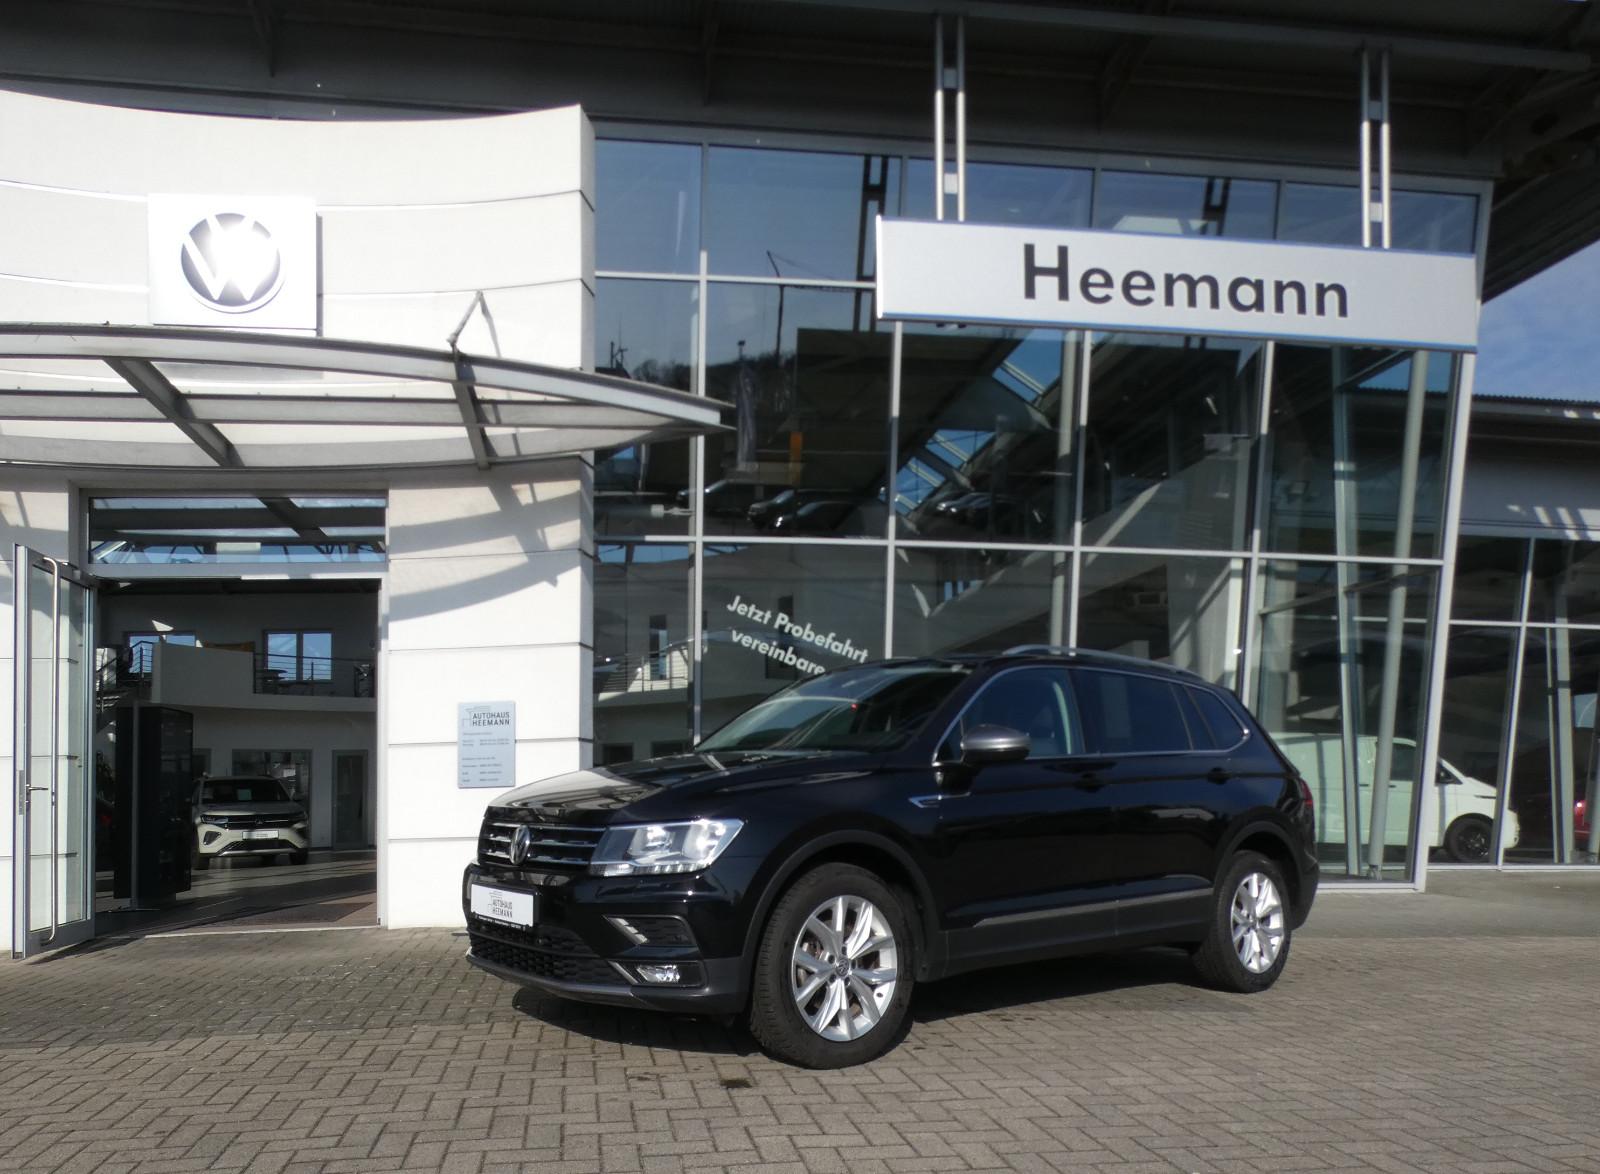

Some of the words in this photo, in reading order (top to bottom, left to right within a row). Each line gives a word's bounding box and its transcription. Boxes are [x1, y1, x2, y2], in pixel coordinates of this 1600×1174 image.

[1023, 243, 1348, 318] Heemann
[726, 595, 772, 625] Jetzt
[773, 612, 869, 663] Probefahrt
[731, 629, 827, 675] vereinbare
[472, 711, 510, 720] AUTOHAUS
